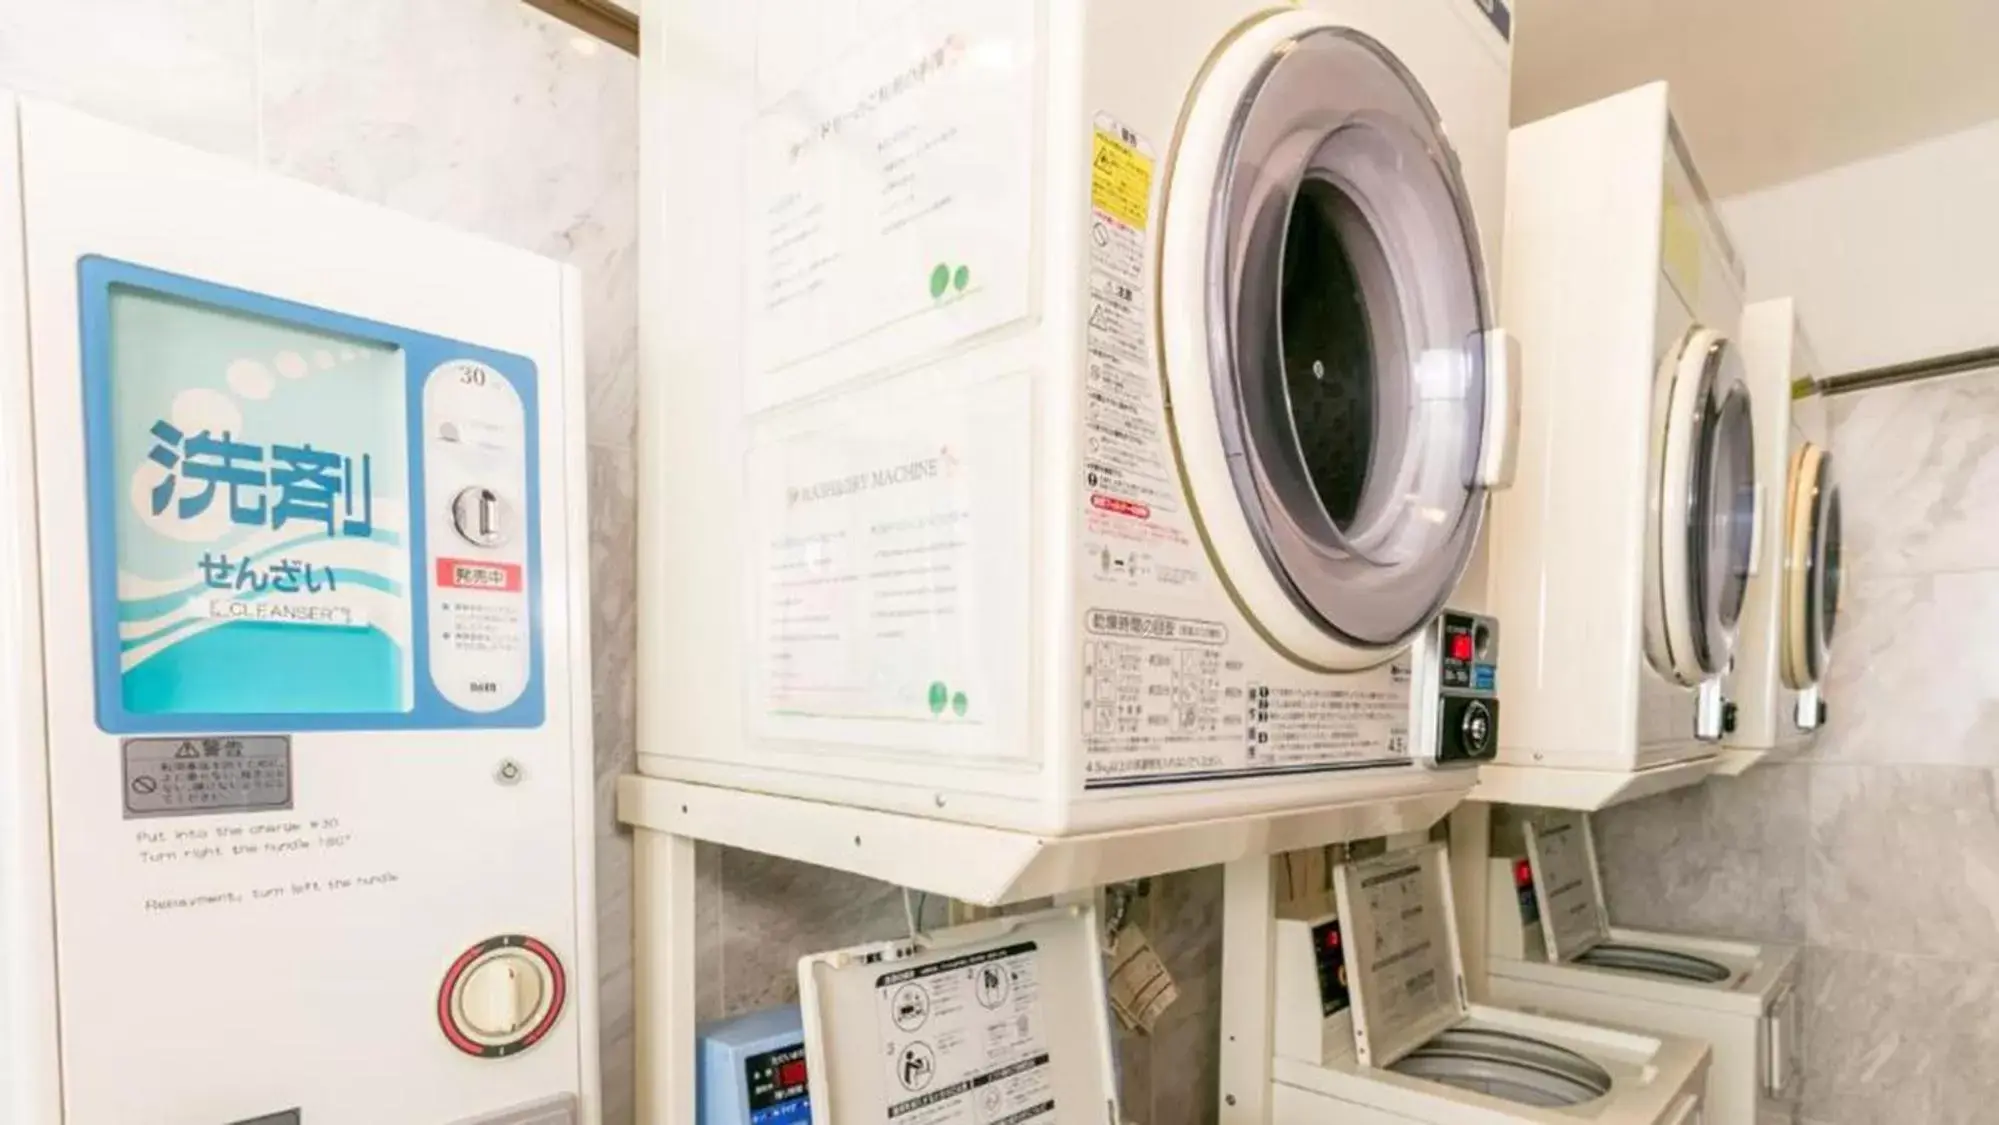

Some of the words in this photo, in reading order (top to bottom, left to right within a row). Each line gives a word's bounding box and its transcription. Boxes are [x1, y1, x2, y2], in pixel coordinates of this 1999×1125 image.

[459, 366, 485, 386] 30
[147, 419, 372, 538] 洗剤
[870, 457, 938, 489] MACHINE
[198, 552, 336, 592] せんざい
